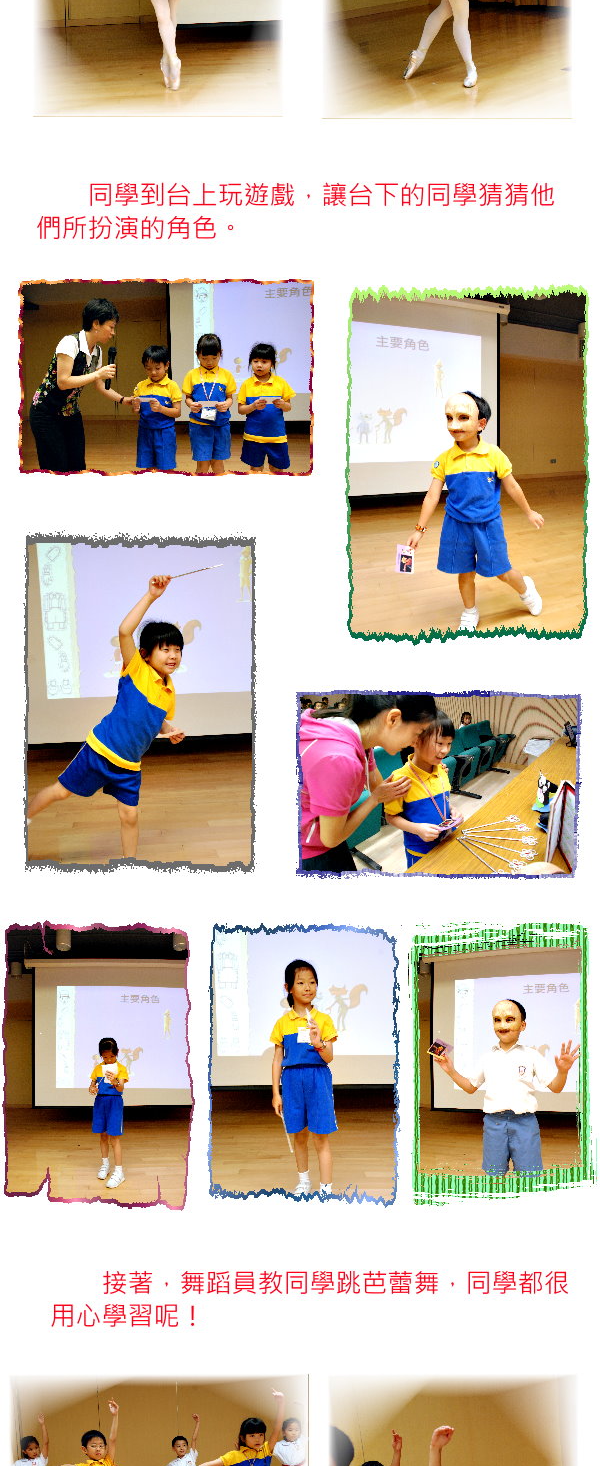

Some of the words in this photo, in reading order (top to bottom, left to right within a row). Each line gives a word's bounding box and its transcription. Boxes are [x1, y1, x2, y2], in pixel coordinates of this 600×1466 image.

[265, 286, 311, 298] 主要角色
[376, 336, 430, 352] 主要角色
[523, 983, 570, 994] 主要角色
[120, 994, 160, 1004] 主要角色
